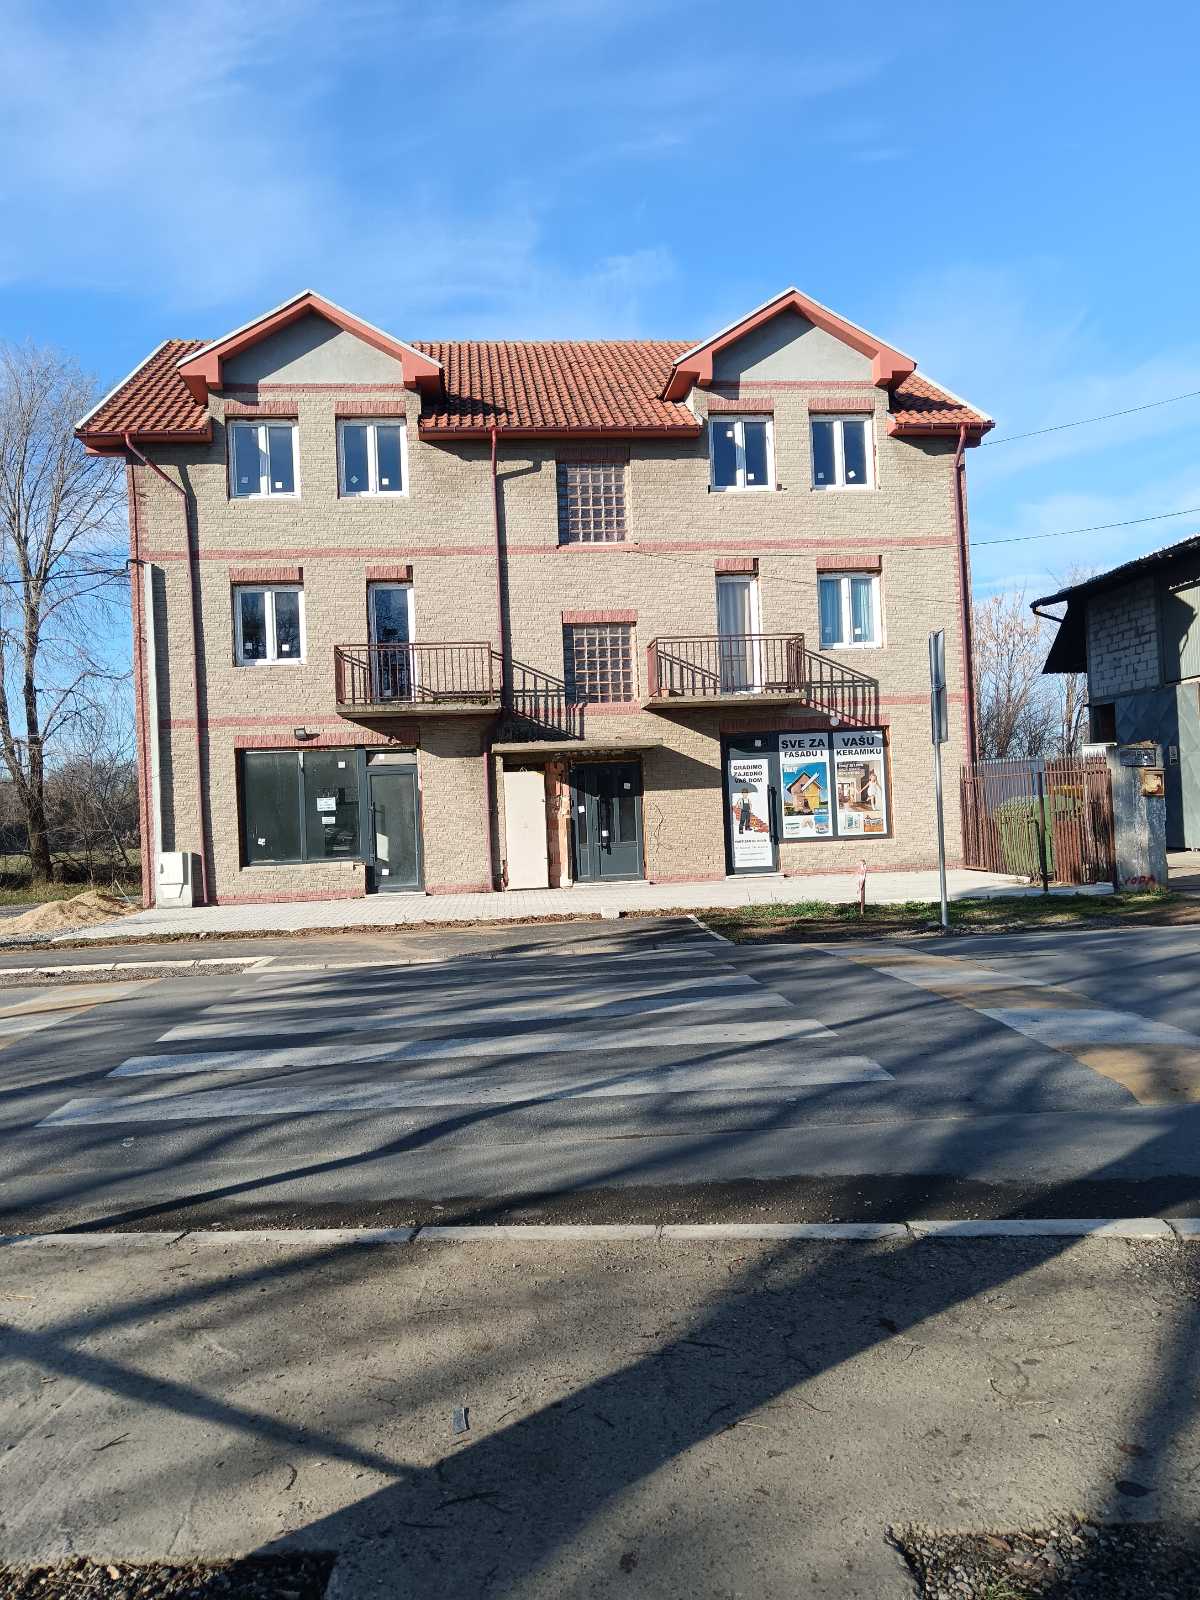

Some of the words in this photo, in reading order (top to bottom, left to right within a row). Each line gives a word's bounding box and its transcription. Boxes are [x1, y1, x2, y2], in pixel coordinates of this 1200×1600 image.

[781, 739, 805, 749] SVE
[809, 738, 826, 748] ZA
[842, 735, 875, 747] VAŠU
[784, 750, 818, 758] FASADU
[836, 748, 882, 756] KERAMIKU
